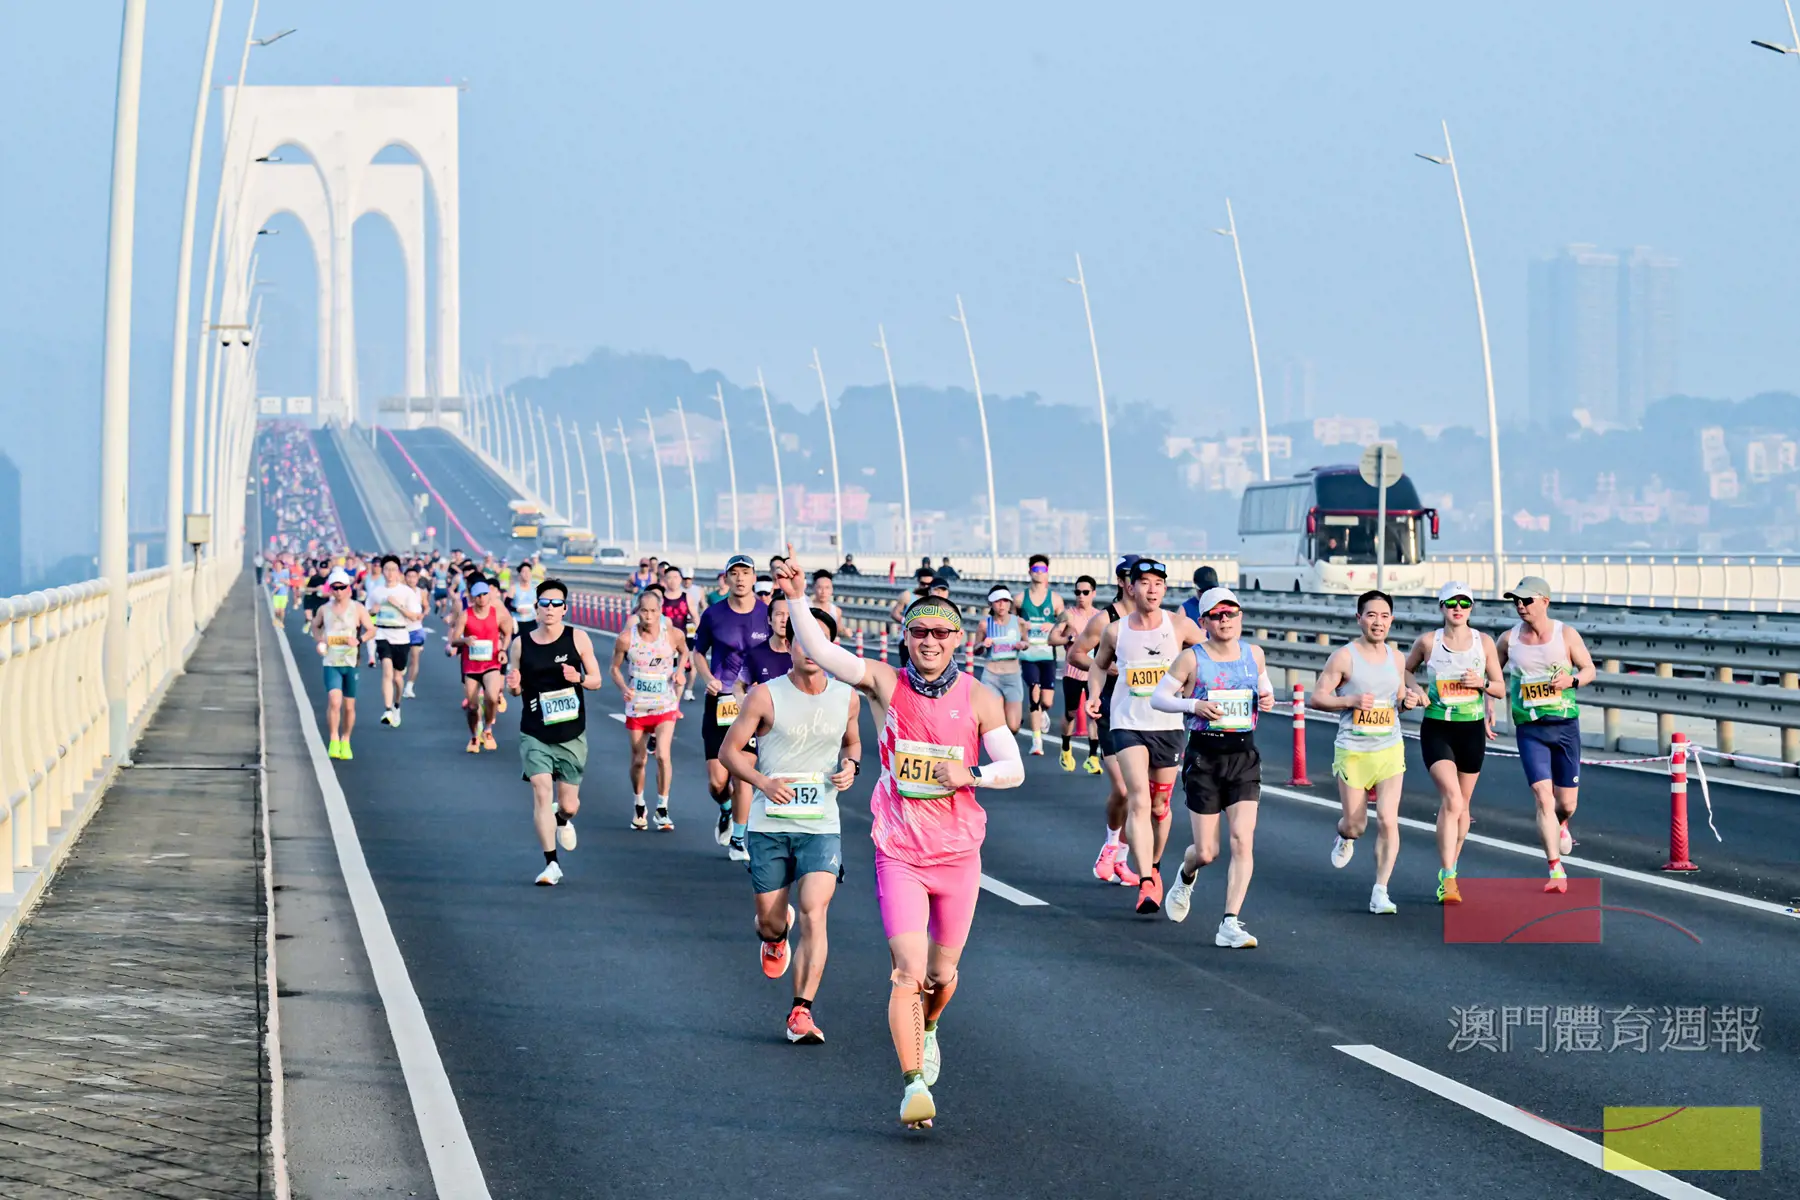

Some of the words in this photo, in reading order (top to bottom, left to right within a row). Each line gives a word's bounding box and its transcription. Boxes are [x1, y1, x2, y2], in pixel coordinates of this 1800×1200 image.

[545, 698, 577, 714] B2033
[1219, 702, 1249, 716] 5413
[1357, 709, 1391, 725] A4364
